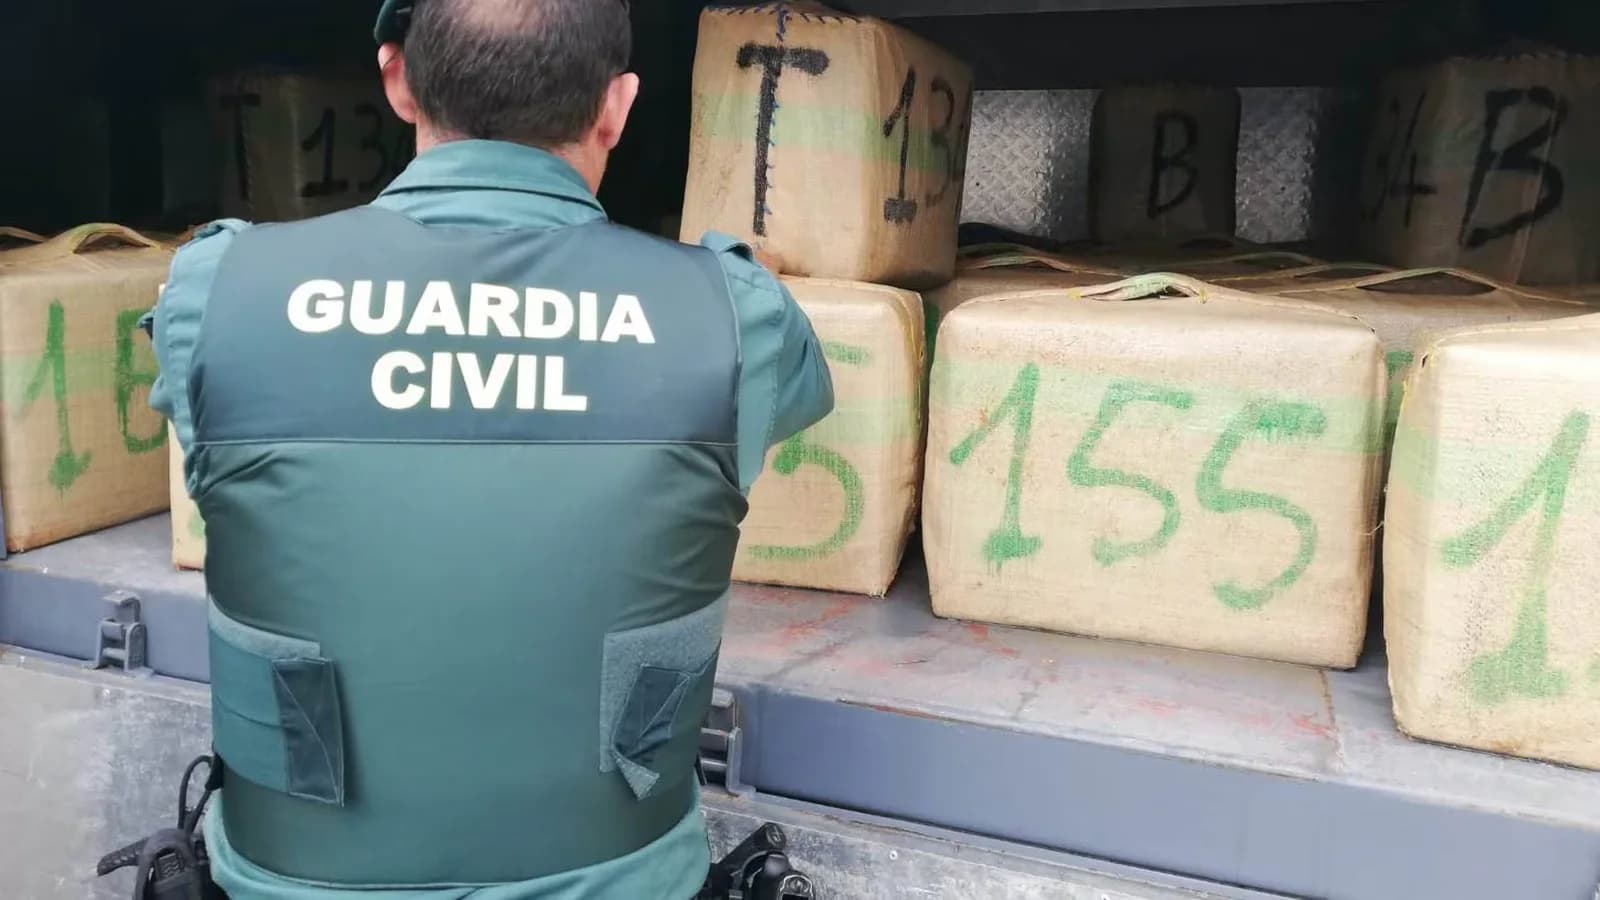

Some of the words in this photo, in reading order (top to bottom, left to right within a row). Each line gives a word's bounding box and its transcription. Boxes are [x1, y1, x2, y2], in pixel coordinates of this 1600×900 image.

[220, 93, 261, 200] T
[737, 43, 829, 237] T
[1147, 110, 1198, 219] B
[1460, 86, 1568, 249] B
[287, 279, 656, 344] GUARDIA
[371, 351, 588, 412] CIVIL
[949, 362, 1326, 611] 155
